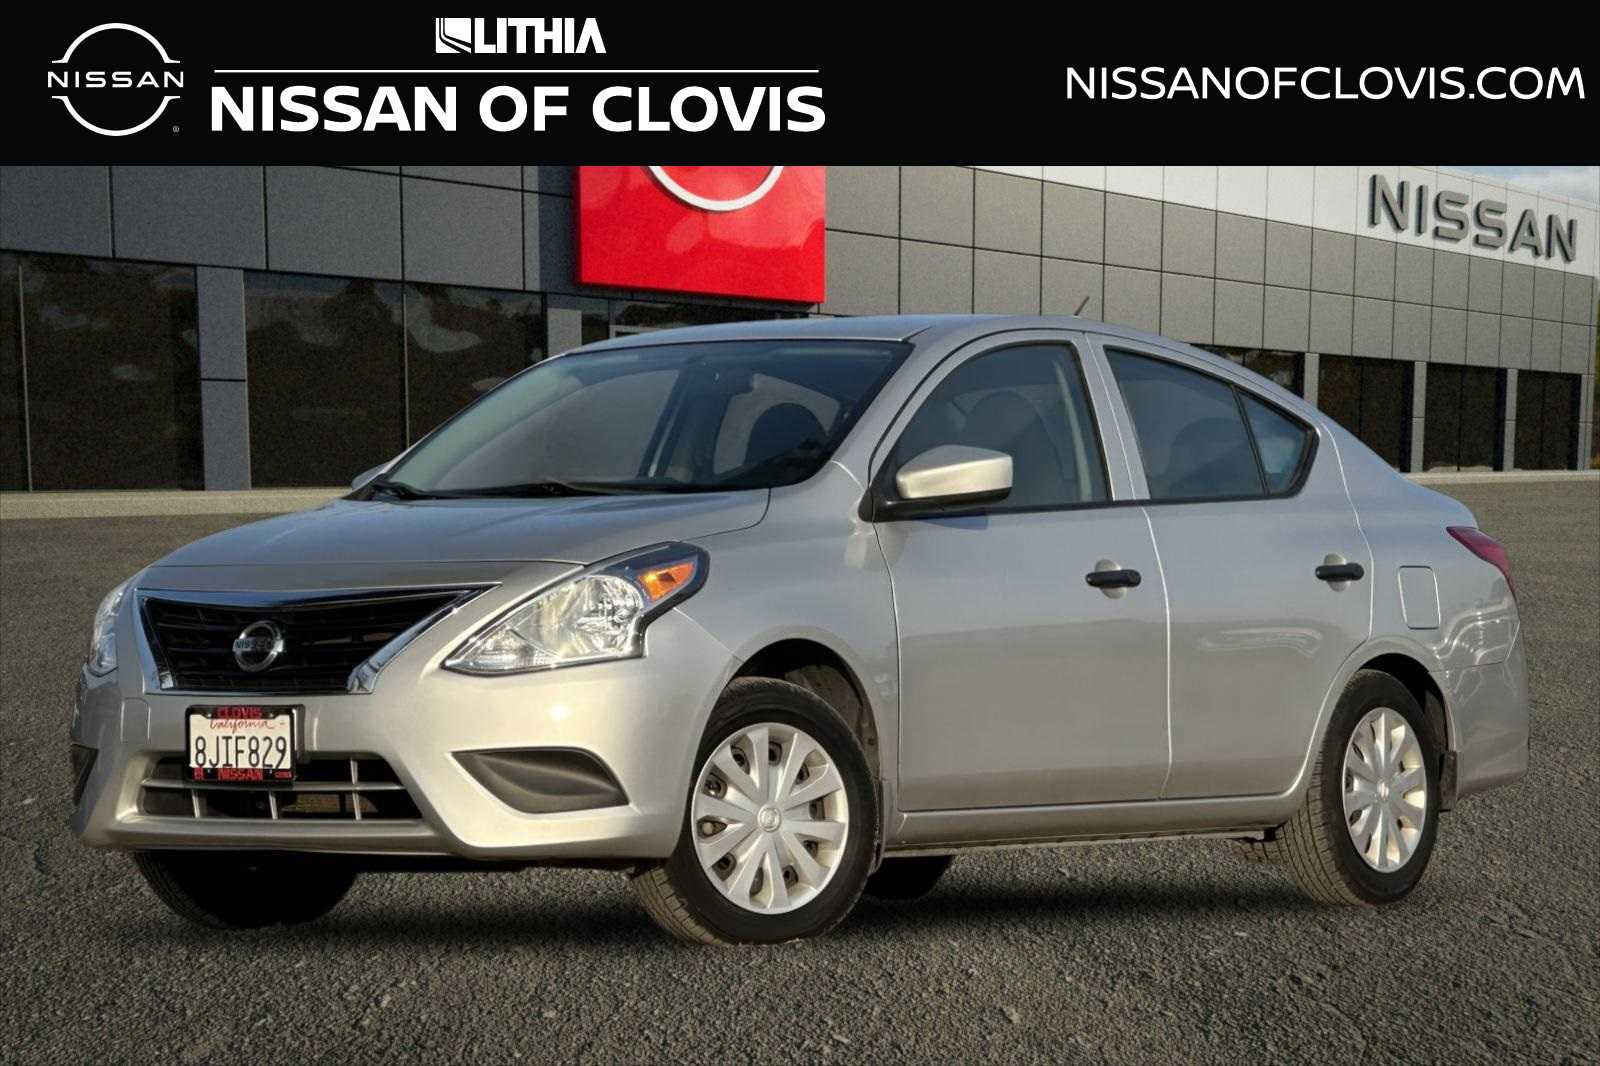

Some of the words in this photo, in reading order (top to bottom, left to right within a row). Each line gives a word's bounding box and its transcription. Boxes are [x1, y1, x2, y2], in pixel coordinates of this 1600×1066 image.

[1369, 174, 1577, 262] NISSAN
[210, 719, 274, 733] California
[195, 736, 287, 768] 8JIF829
[219, 768, 264, 780] NISSAN
